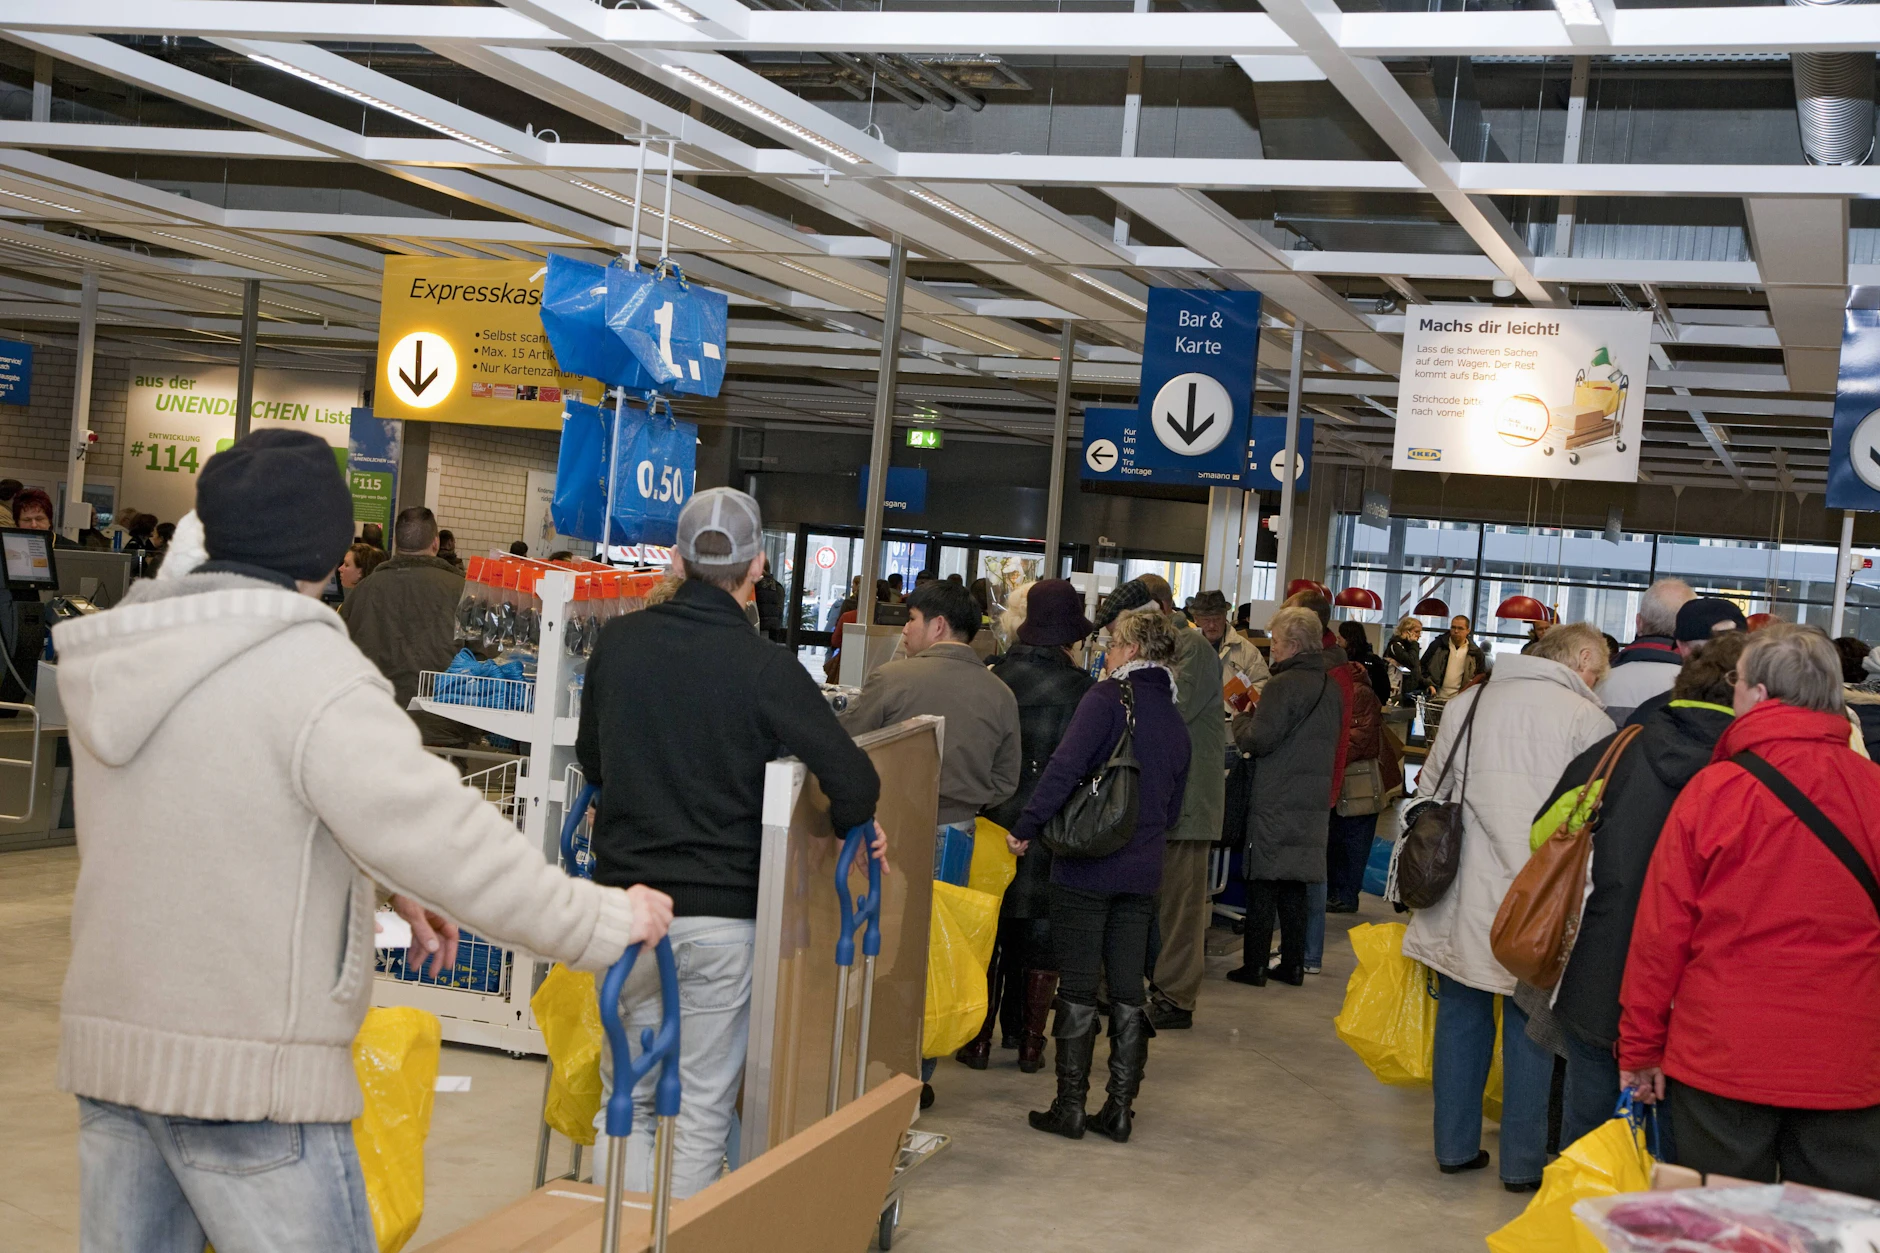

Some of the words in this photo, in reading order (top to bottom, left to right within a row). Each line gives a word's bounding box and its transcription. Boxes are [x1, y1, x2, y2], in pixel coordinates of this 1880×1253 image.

[1179, 310, 1207, 327] Bar
[1210, 312, 1224, 328] &
[1419, 318, 1473, 333] Machs
[1478, 320, 1502, 334] dir
[1507, 321, 1560, 336] leicht!
[482, 329, 517, 342] Selbst
[1176, 336, 1222, 355] Karte
[1417, 344, 1438, 354] Lass
[1440, 346, 1454, 354] die
[1456, 346, 1500, 356] schweren
[1503, 348, 1538, 357] Sachen
[482, 346, 507, 358] Max.
[512, 348, 525, 359] 15
[480, 362, 500, 374] Nur
[1416, 357, 1431, 366] auf
[1432, 358, 1454, 367] dem
[1457, 359, 1491, 370] Wagen.
[1494, 360, 1512, 369] Der
[1514, 361, 1536, 370] Rest
[1414, 370, 1447, 380] kommt
[1450, 370, 1470, 380] aufs
[135, 375, 164, 388] aus
[169, 376, 197, 390] der
[1412, 394, 1460, 406] Strichcode
[155, 394, 309, 422] UNENDLCHEN
[1412, 407, 1433, 416] nach
[1436, 408, 1465, 418] vorne!
[148, 432, 201, 443] ENTWICKLUNG
[130, 441, 200, 474] #114
[1121, 467, 1153, 476] Montage
[352, 476, 382, 491] #115
[636, 460, 684, 505] 0.50
